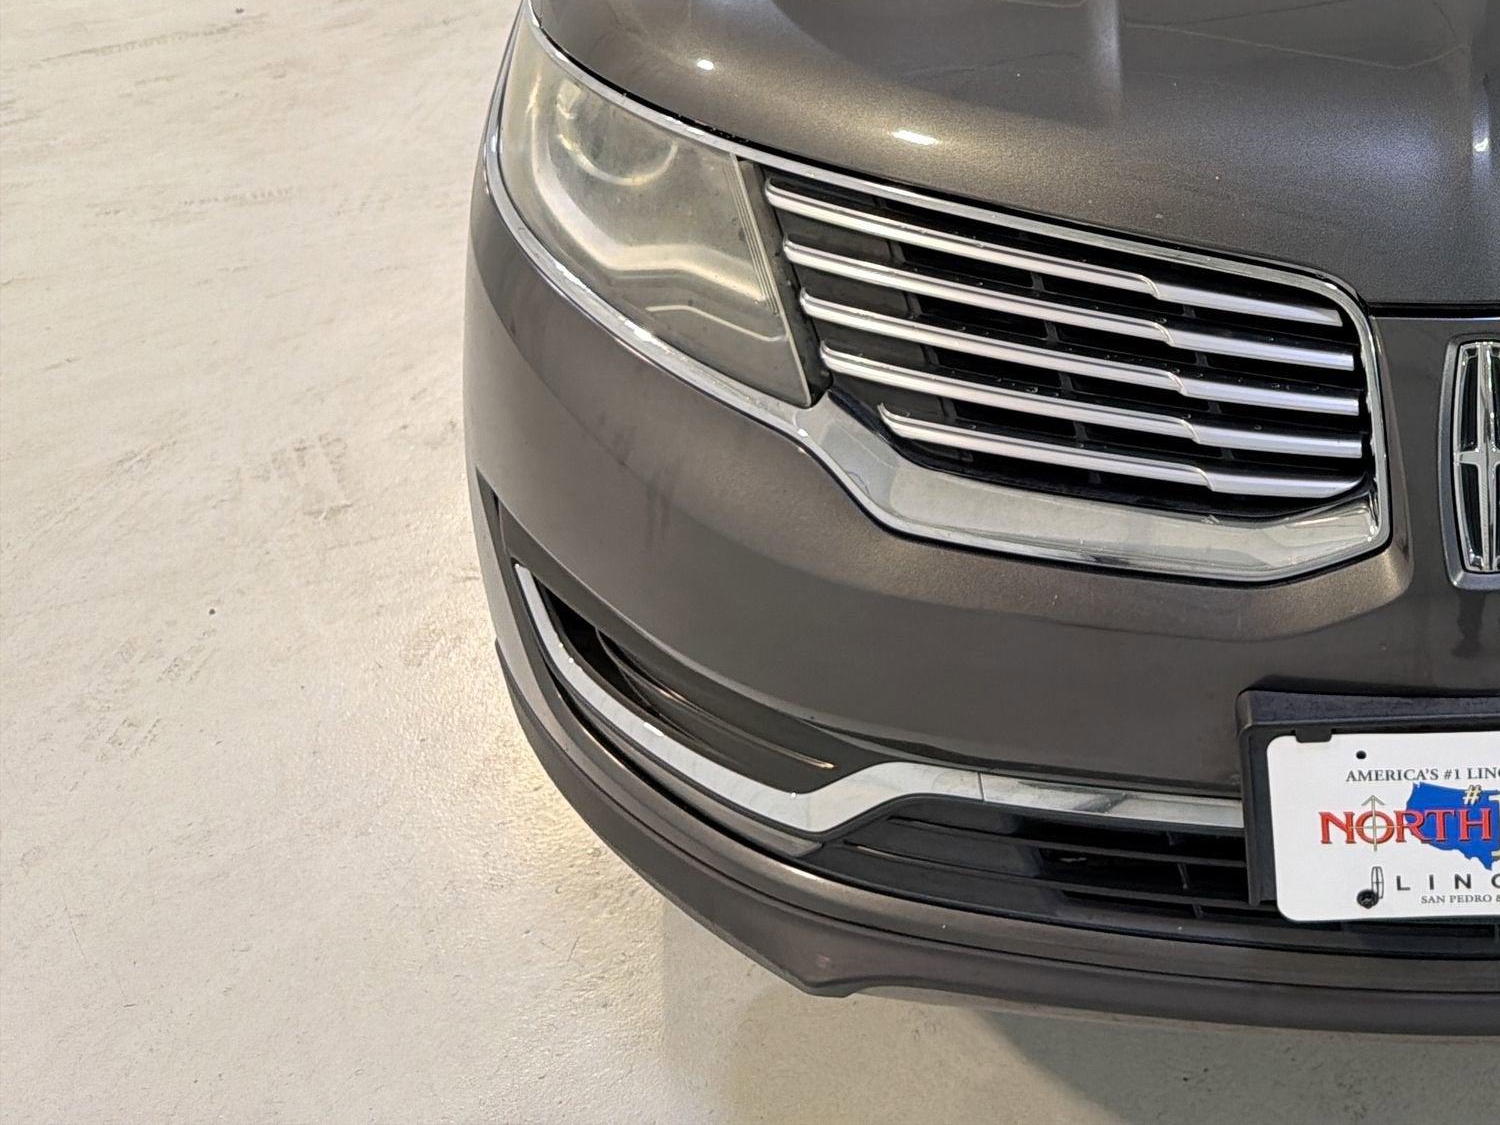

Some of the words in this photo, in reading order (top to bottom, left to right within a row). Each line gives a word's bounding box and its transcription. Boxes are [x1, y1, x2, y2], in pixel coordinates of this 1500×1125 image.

[1346, 767, 1439, 783] AMERICA'S
[1443, 767, 1460, 780] #1
[1320, 807, 1492, 844] NORTH
[1421, 895, 1447, 905] SAN
[1449, 894, 1493, 905] PEDRO
